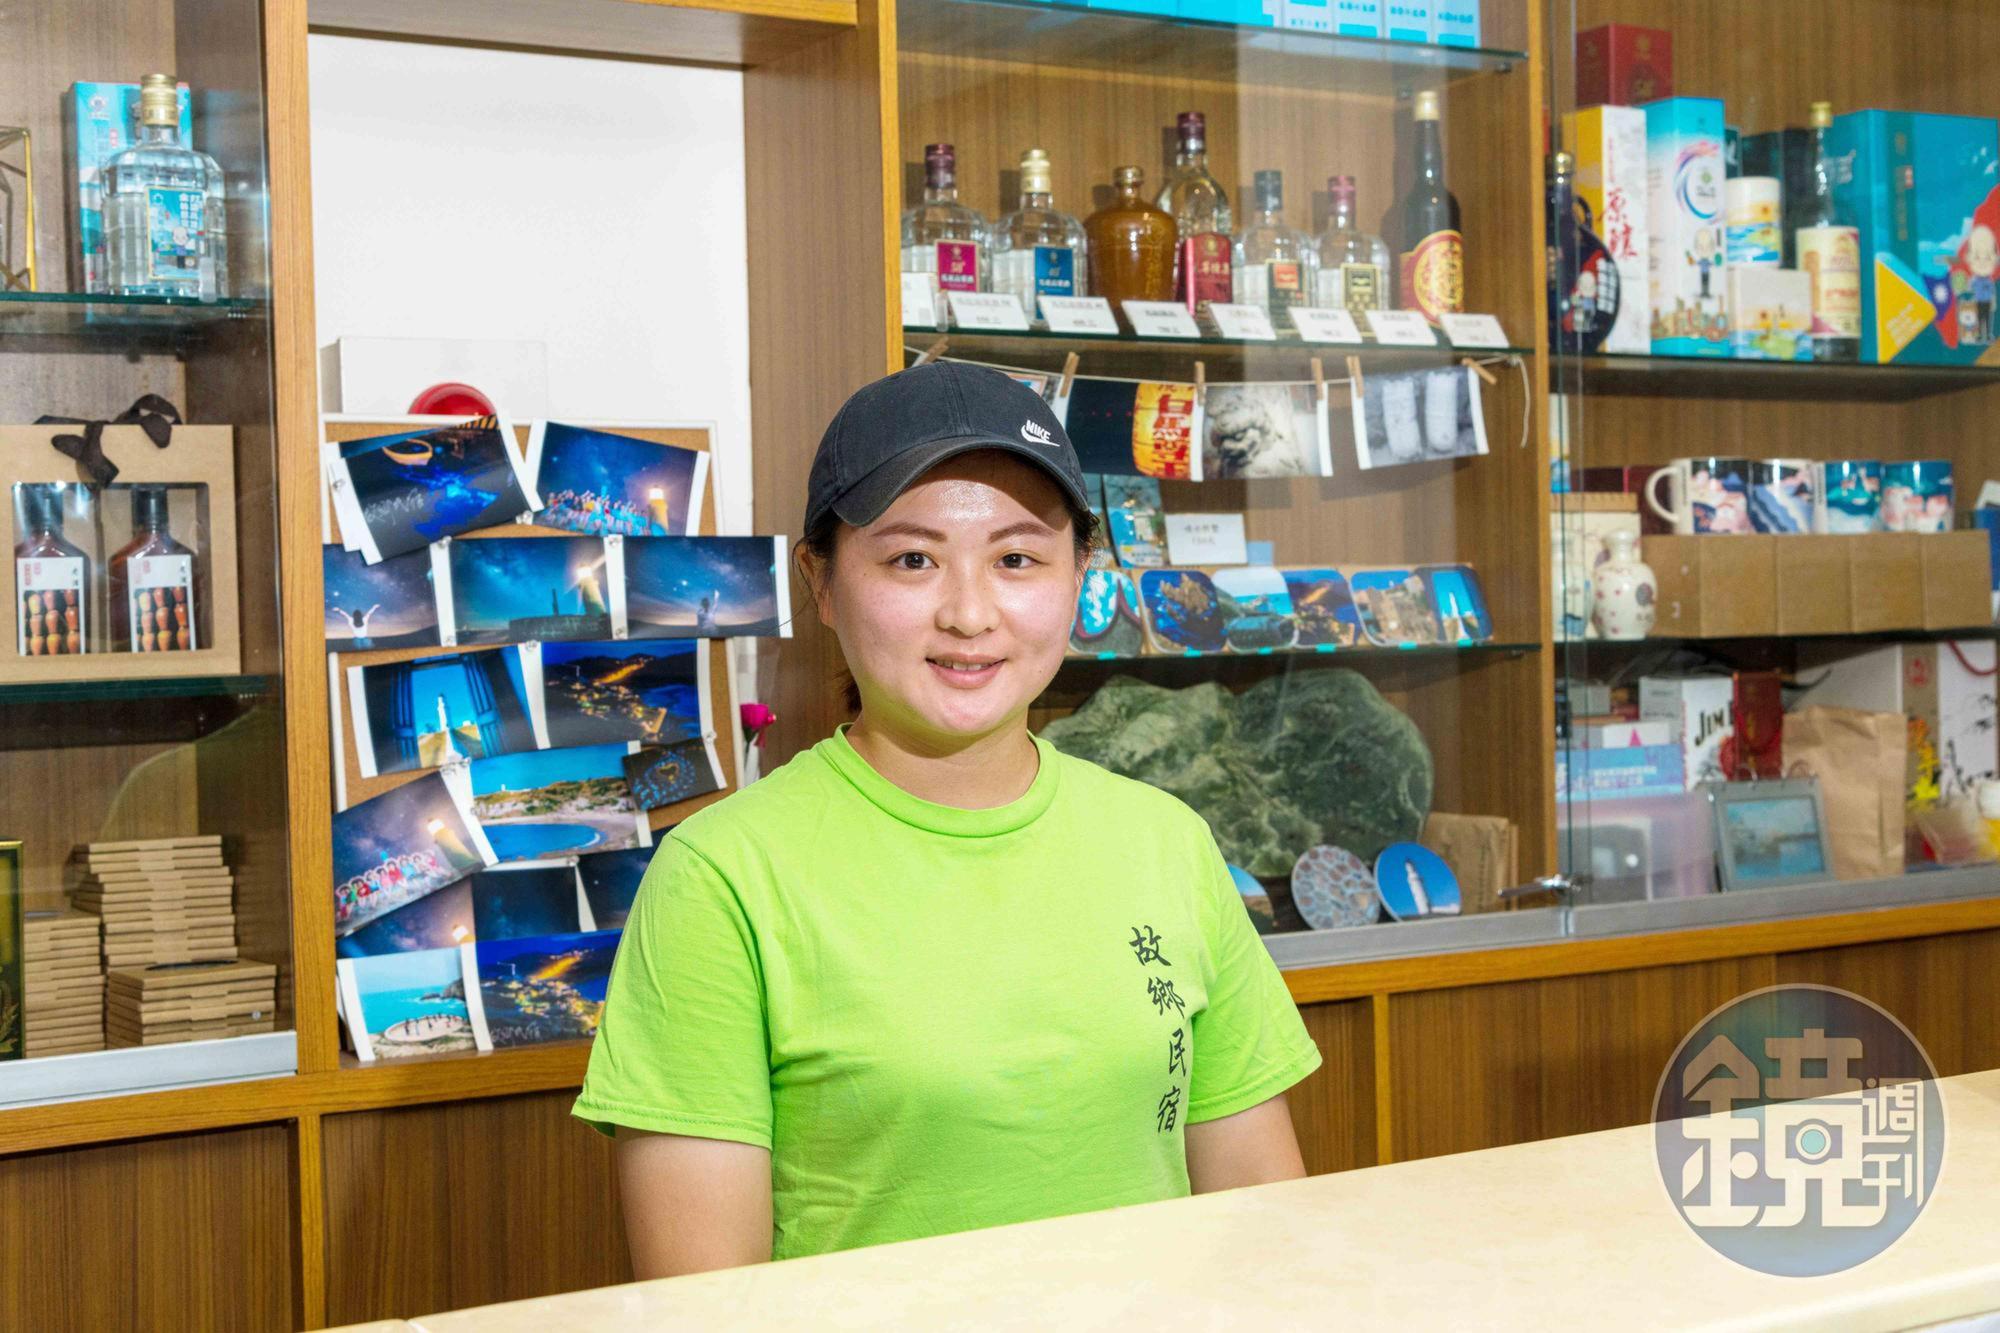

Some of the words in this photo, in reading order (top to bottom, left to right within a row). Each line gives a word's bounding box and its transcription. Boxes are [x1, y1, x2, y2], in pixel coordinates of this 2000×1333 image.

[1025, 419, 1052, 442] NIKE
[1128, 924, 1187, 1134] 故鄉民宿
